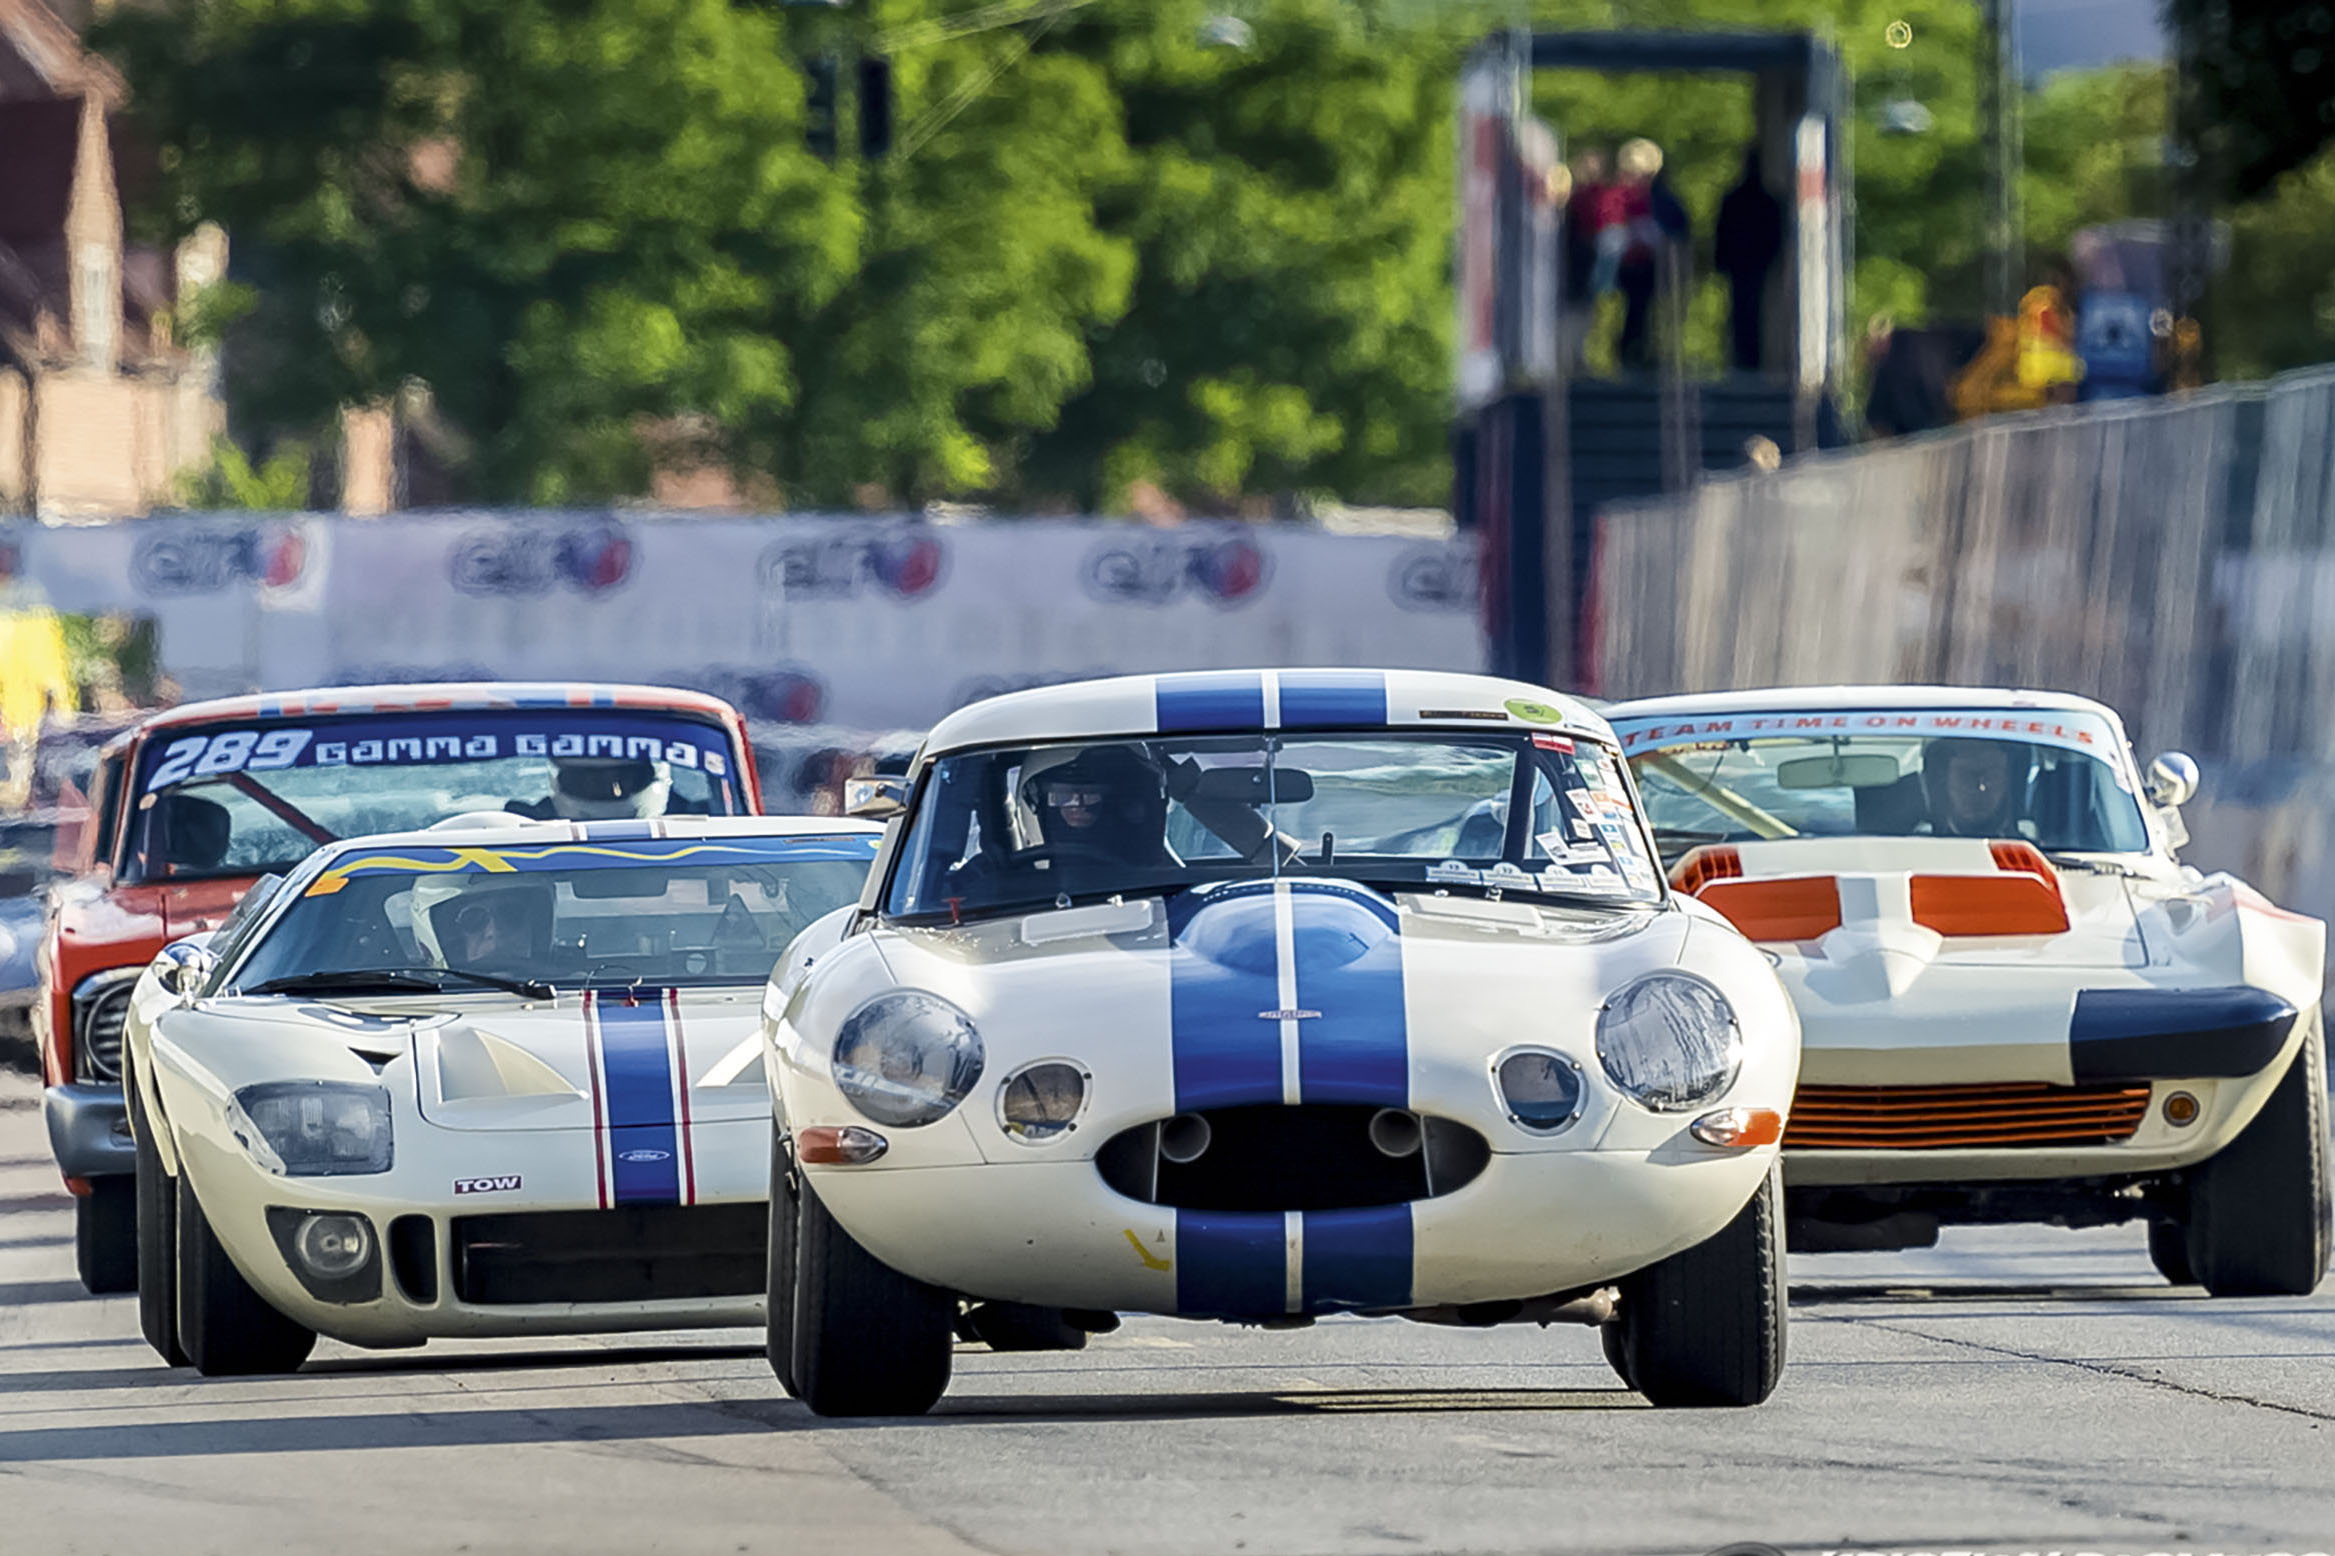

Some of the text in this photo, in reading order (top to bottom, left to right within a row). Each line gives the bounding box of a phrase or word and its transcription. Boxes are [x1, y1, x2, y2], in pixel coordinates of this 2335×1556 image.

[1624, 716, 2094, 747] TEAM TIME ON WHEELS
[147, 729, 313, 792] 289
[457, 1177, 518, 1192] TOW
